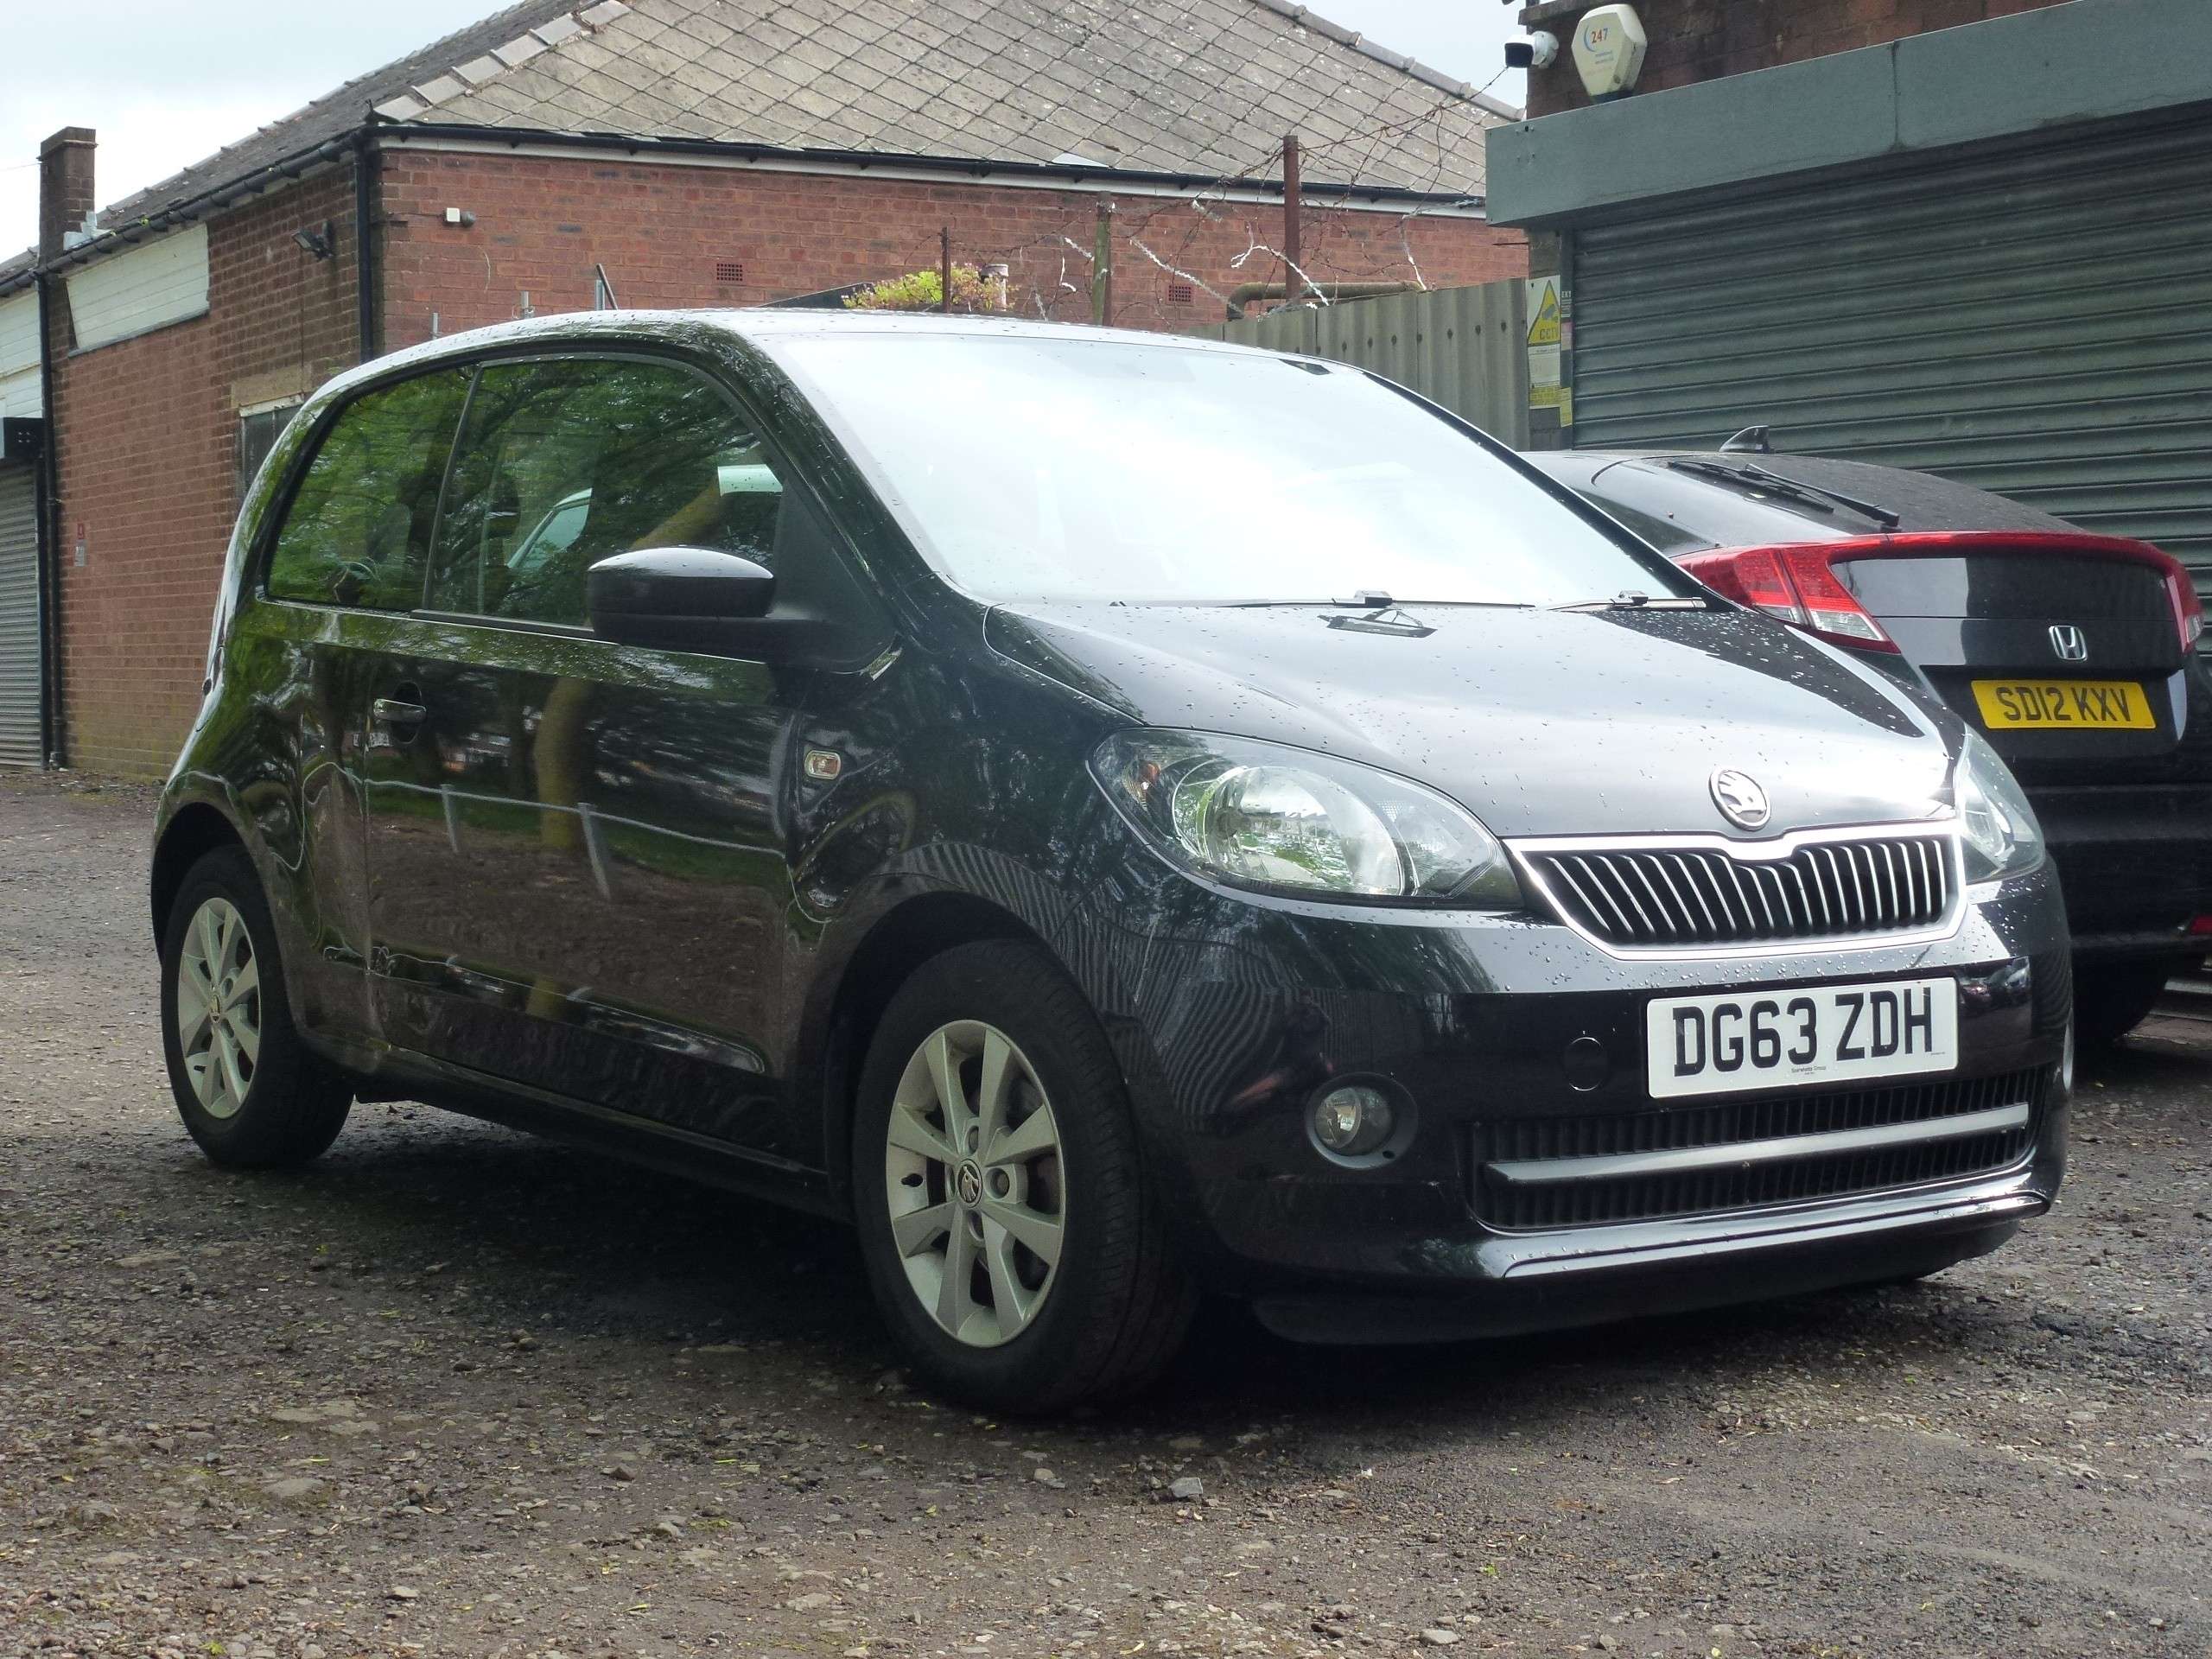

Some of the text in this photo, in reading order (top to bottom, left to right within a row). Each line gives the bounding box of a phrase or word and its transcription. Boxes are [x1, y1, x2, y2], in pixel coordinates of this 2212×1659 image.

[1591, 27, 1609, 43] 247
[1995, 686, 2132, 722] SD12 KXV
[1672, 987, 1933, 1077] DG63 ZDH
